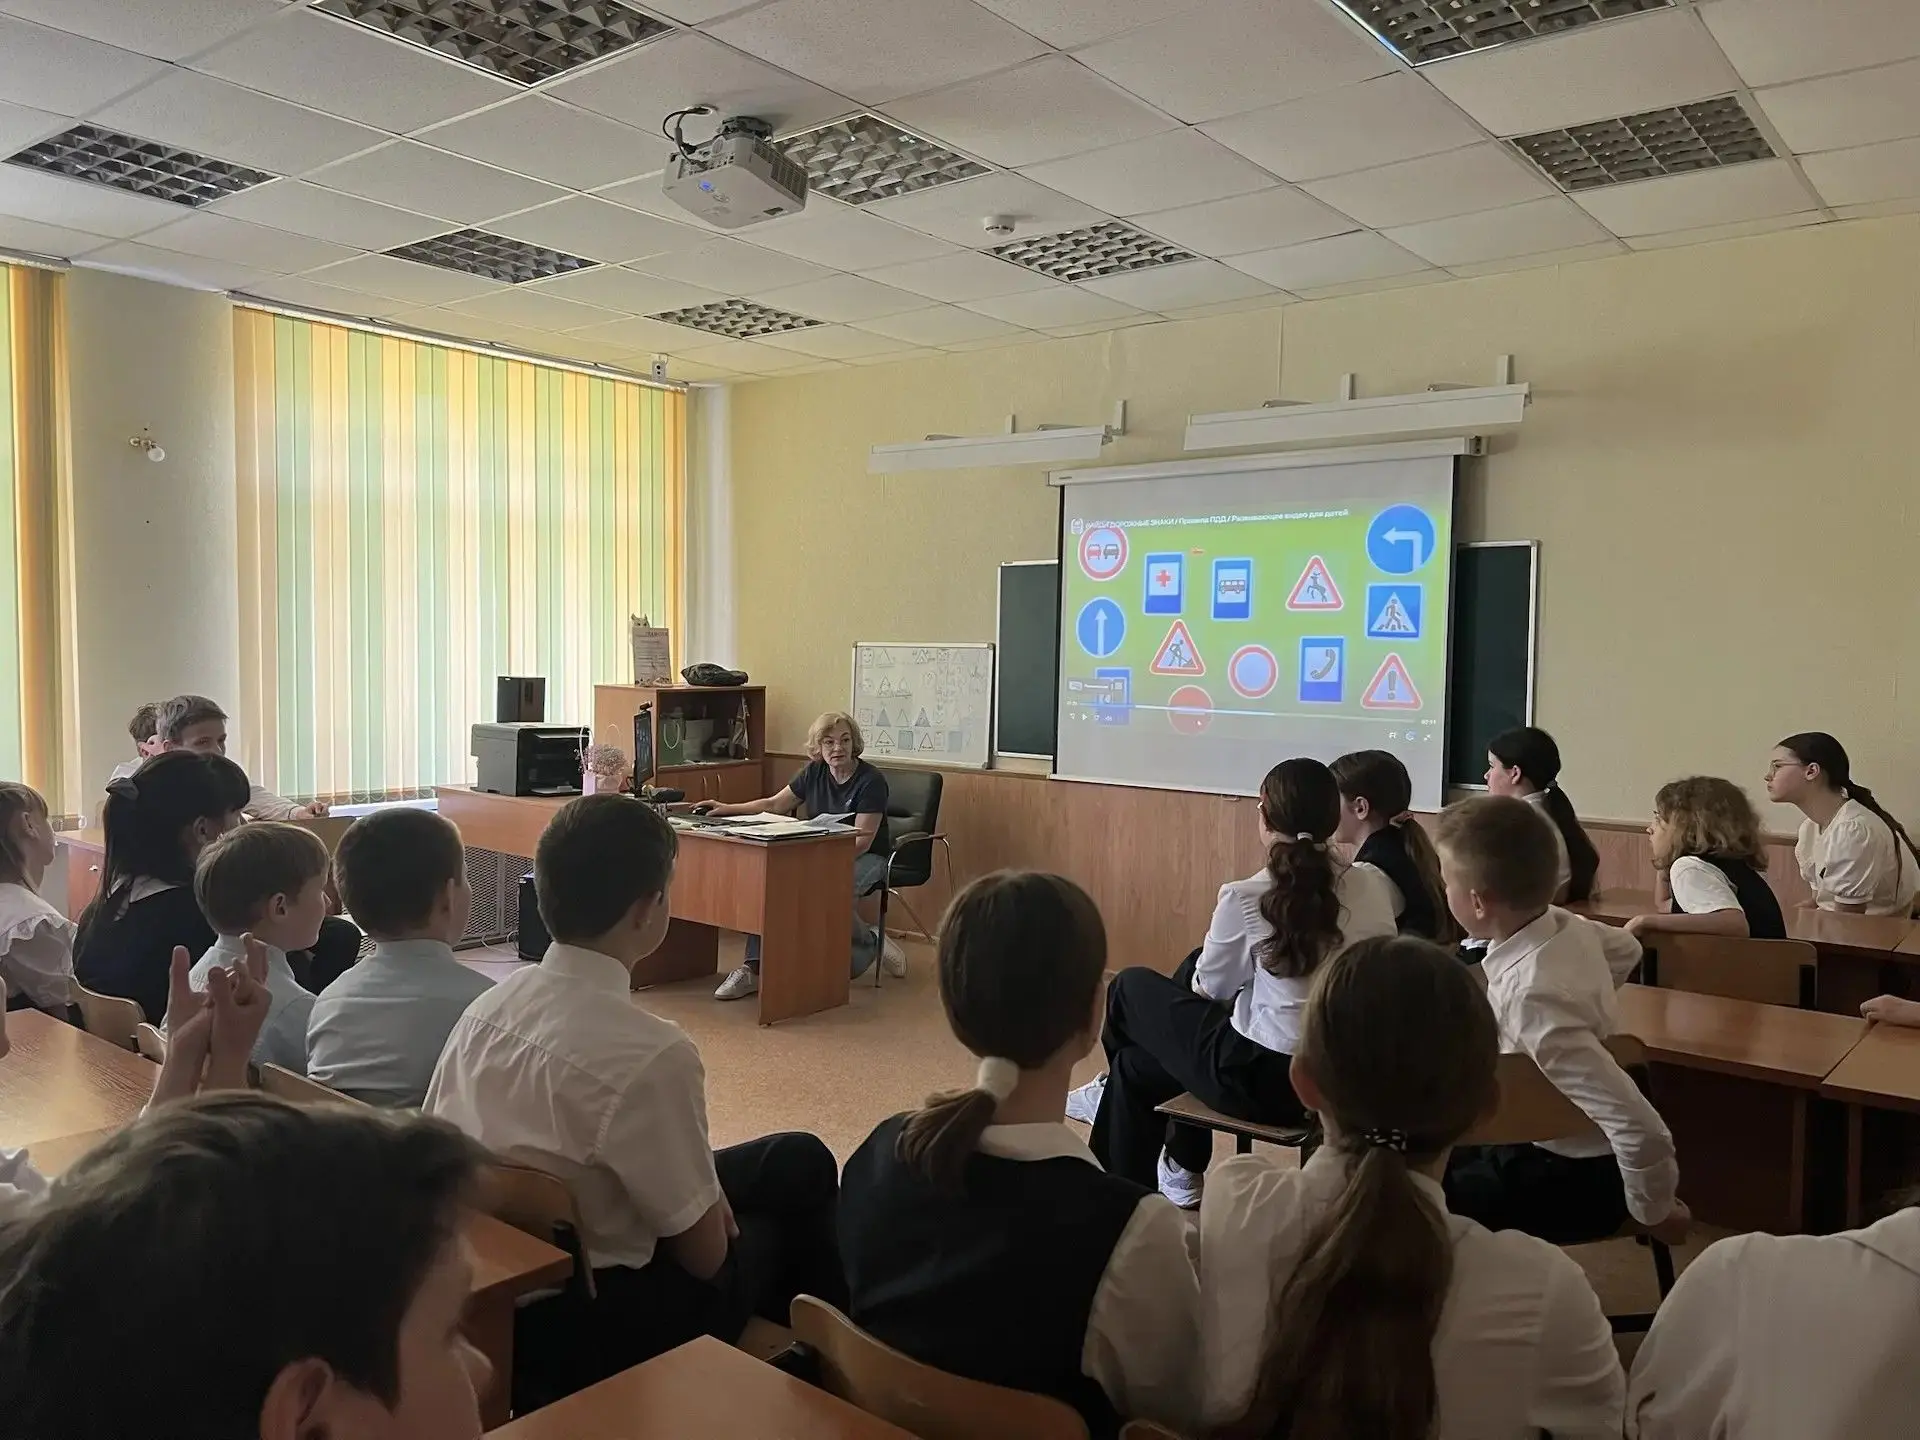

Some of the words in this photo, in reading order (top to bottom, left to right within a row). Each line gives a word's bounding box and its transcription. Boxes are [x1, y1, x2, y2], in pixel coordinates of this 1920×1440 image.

[1210, 515, 1226, 524] ПДД
[1308, 510, 1324, 519] для
[1324, 508, 1348, 518] детей
